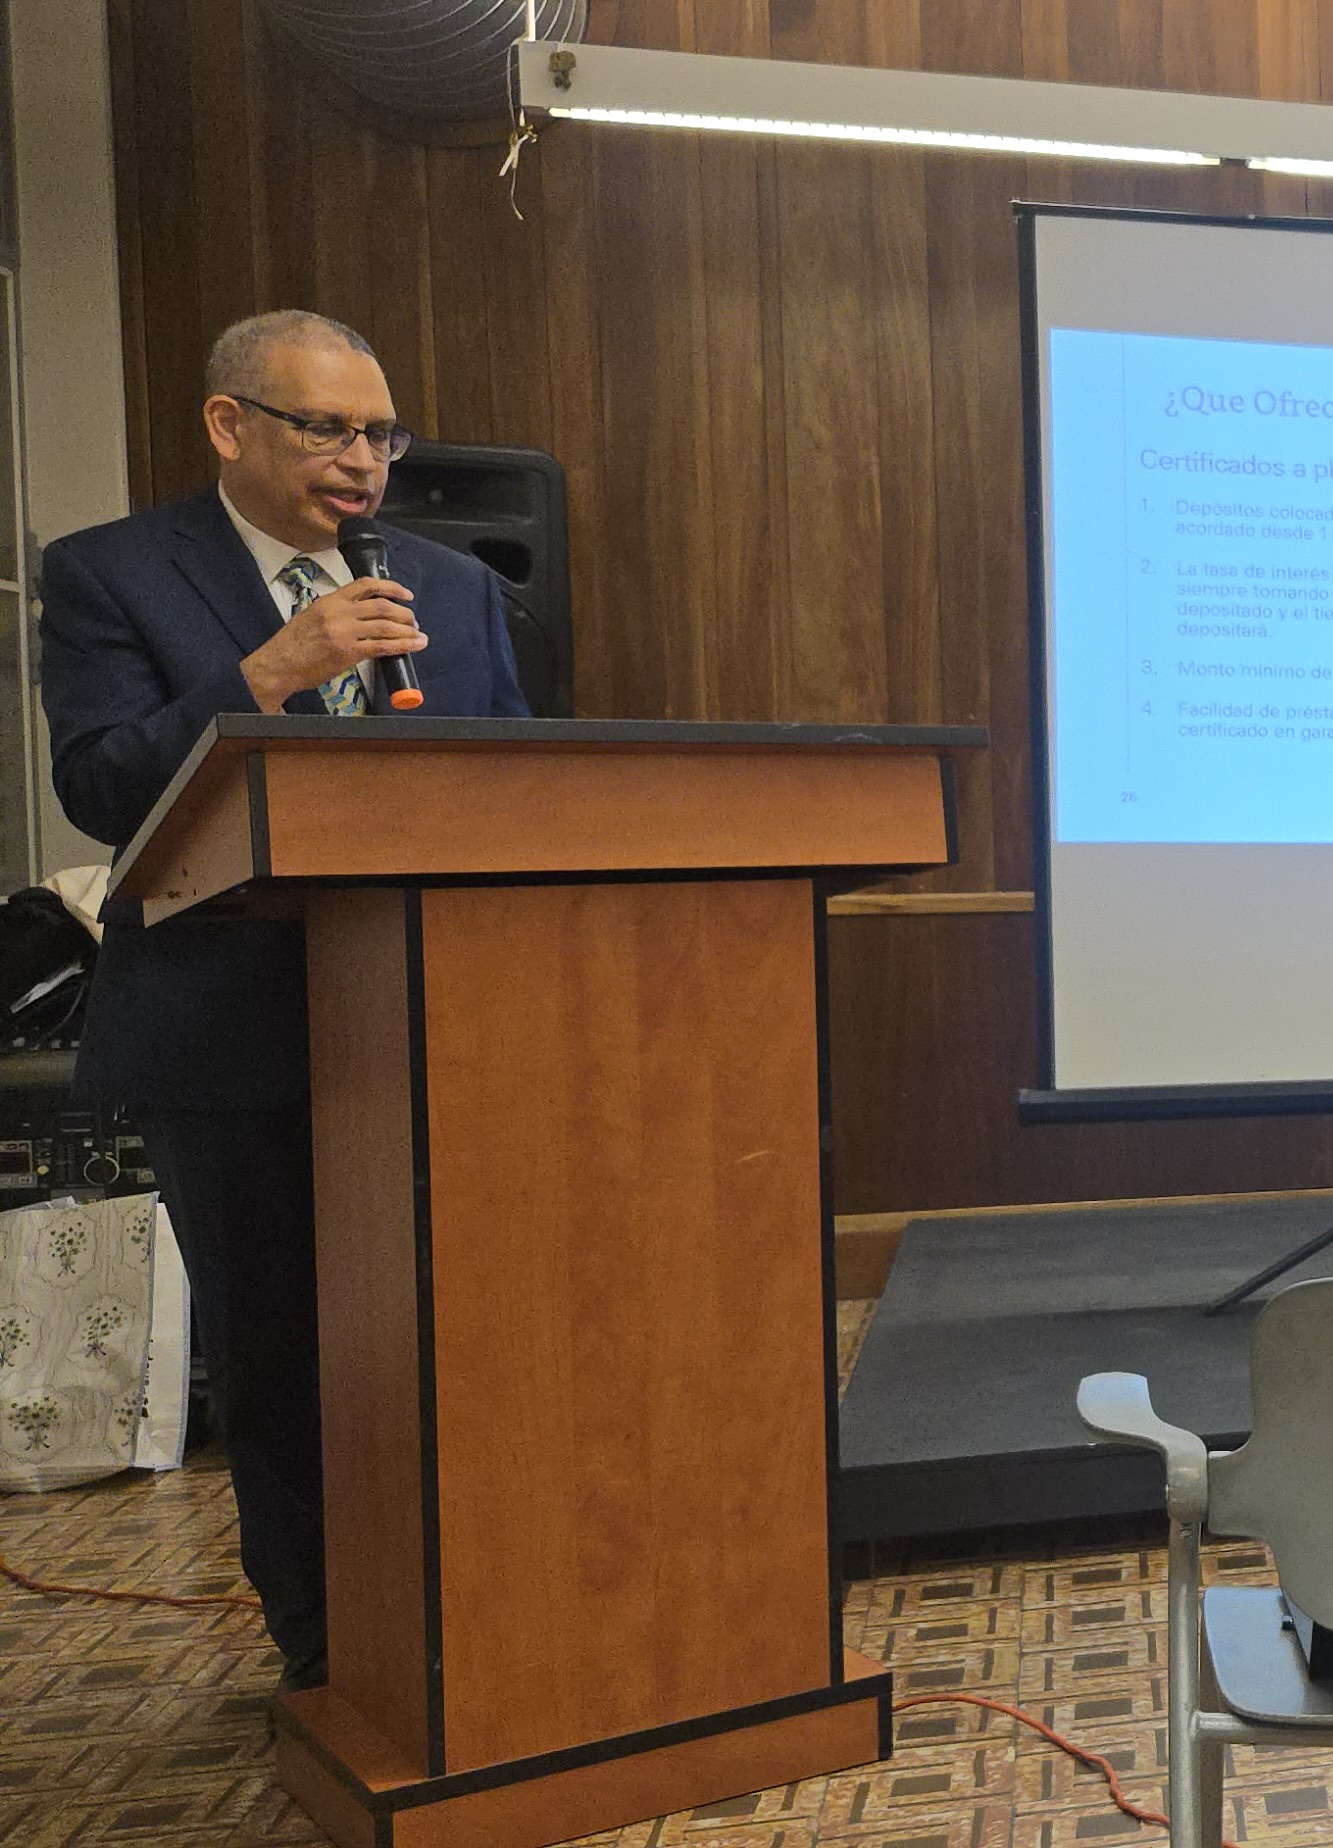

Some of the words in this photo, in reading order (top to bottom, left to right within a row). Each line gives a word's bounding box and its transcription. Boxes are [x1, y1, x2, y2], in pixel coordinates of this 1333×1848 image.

[1164, 385, 1245, 418] ¿Que
[1140, 448, 1286, 477] Certificados
[1293, 462, 1307, 478] a
[1175, 521, 1256, 538] acordado
[1261, 524, 1314, 541] desde
[1319, 526, 1327, 541] 1
[1141, 558, 1157, 575] 2.
[1176, 560, 1197, 576] La
[1203, 562, 1239, 578] tasa
[1244, 564, 1265, 579] de
[1271, 565, 1330, 582] interés
[1176, 581, 1248, 599] siempre
[1253, 584, 1329, 601] tomando
[1176, 601, 1273, 620] depositado
[1278, 606, 1288, 621] y
[1293, 605, 1309, 621] el
[1141, 659, 1158, 676] 3.
[1177, 660, 1236, 677] Monto
[1311, 665, 1332, 680] de
[1177, 701, 1253, 718] Facilidad
[1258, 702, 1280, 718] de
[1178, 722, 1269, 738] certificado
[1274, 727, 1295, 739] en
